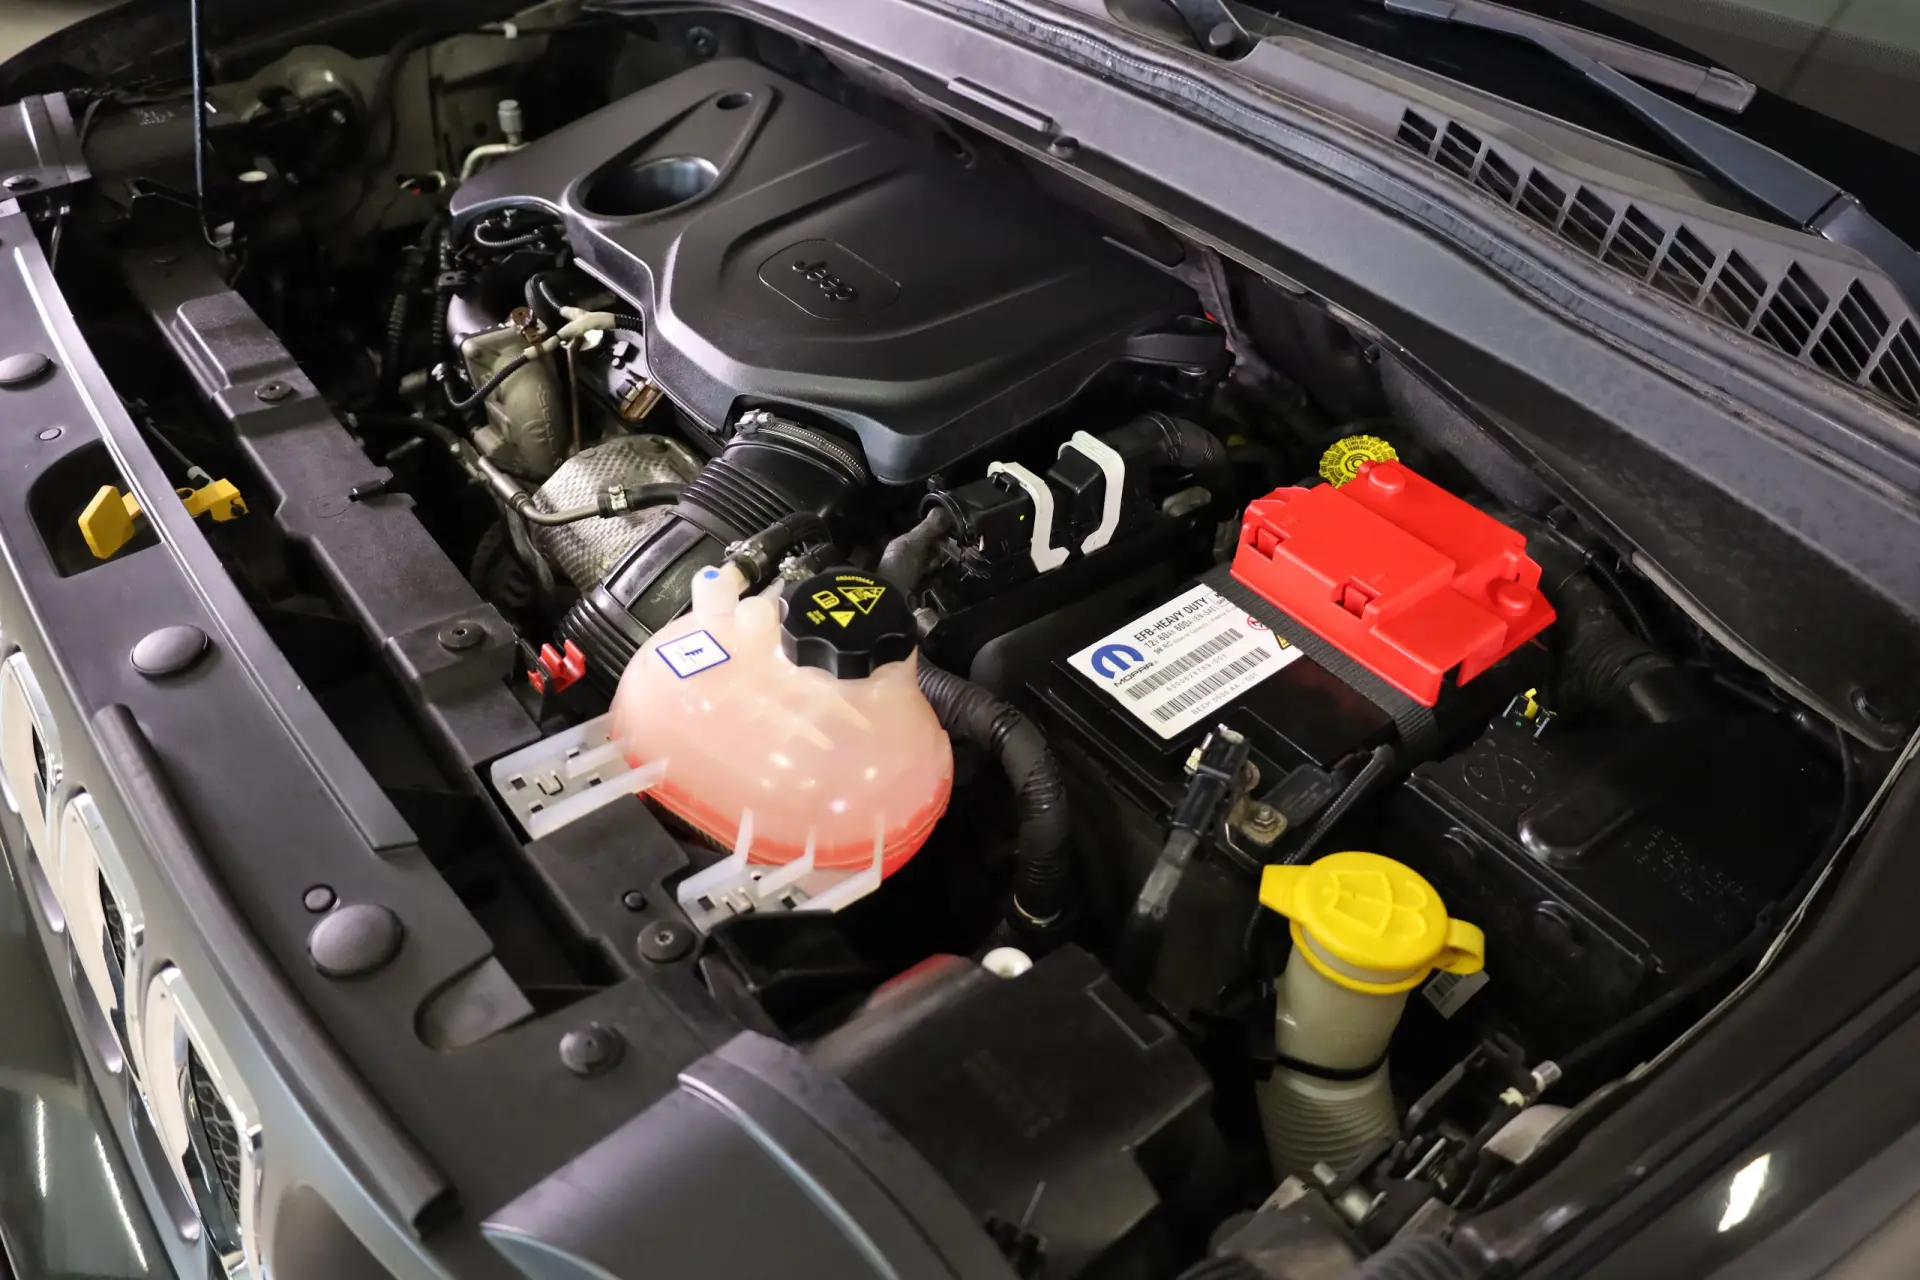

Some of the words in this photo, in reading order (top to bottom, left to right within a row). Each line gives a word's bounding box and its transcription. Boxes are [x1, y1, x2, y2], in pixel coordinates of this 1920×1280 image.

[789, 258, 858, 301] Jeep
[1133, 611, 1186, 642] EFB-HEAVY
[1184, 597, 1209, 614] DUTY
[1113, 661, 1155, 687] MOPAR
